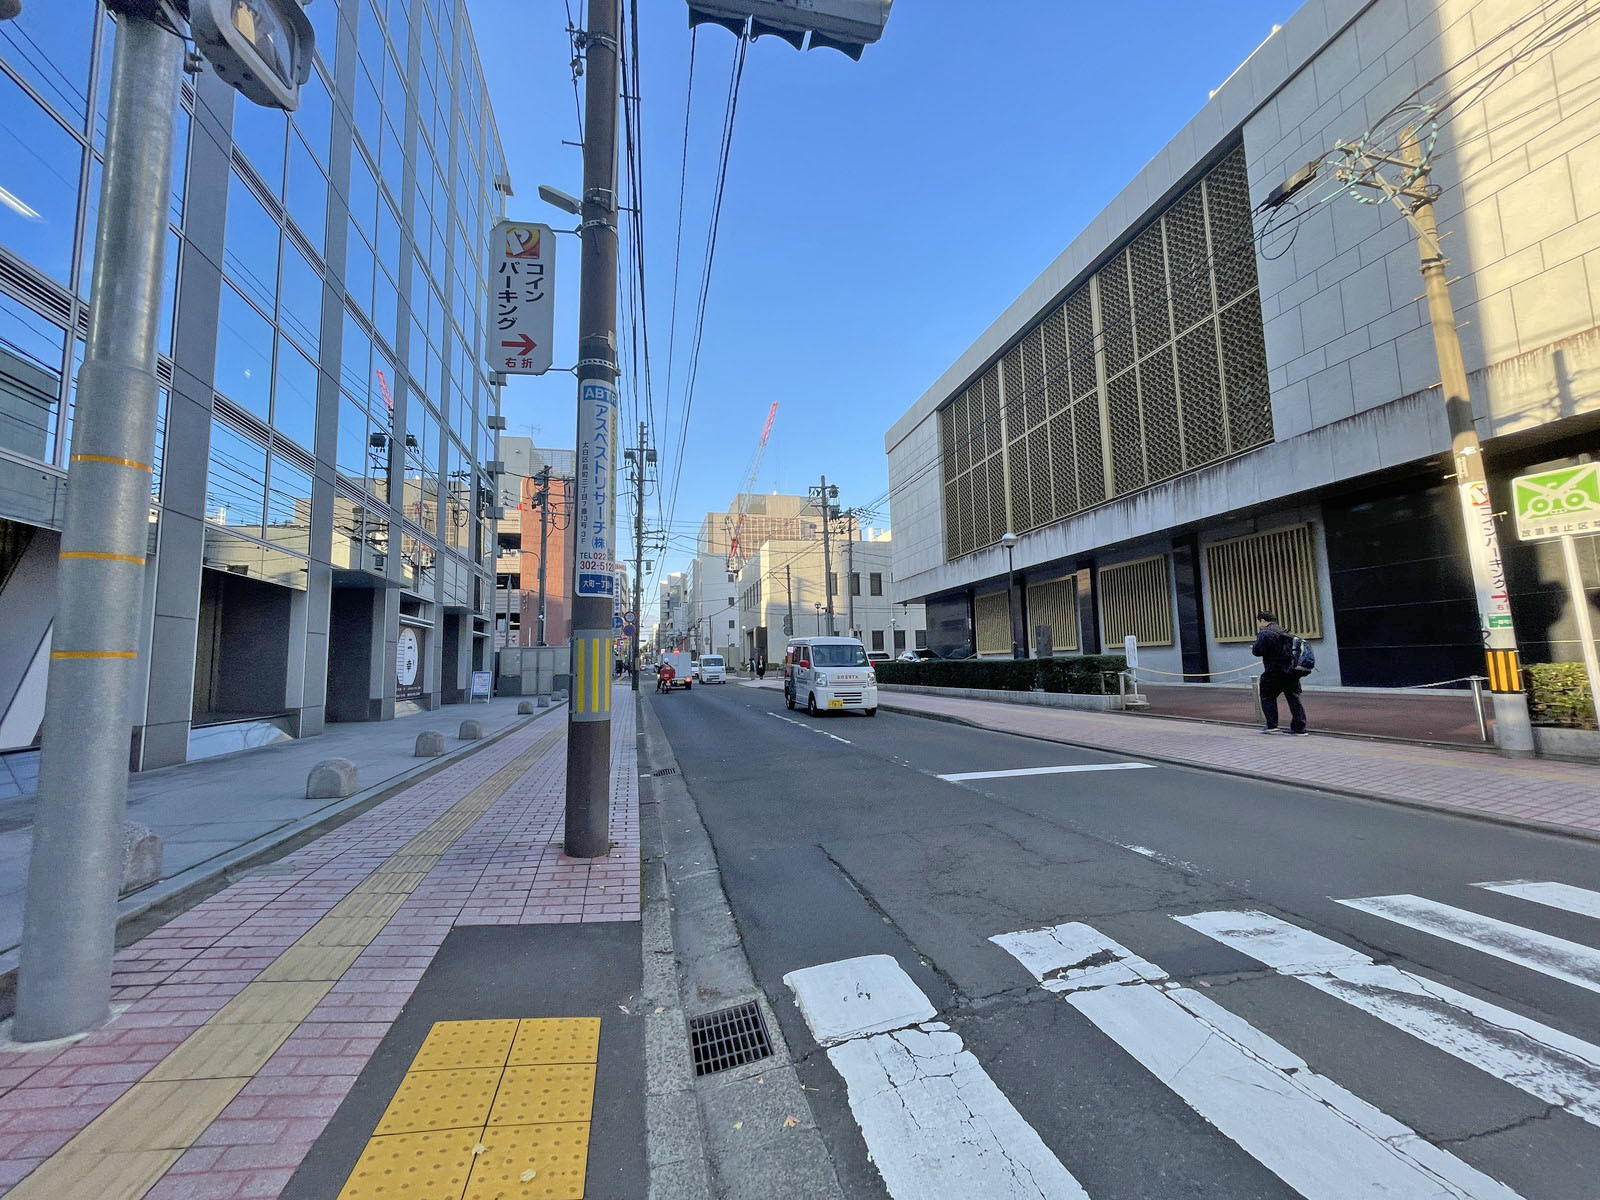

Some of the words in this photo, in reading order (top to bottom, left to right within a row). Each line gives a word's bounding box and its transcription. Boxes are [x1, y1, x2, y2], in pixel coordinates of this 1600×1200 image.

[497, 261, 521, 331] パーキング
[525, 262, 544, 303] コイン
[505, 357, 533, 369] 右折
